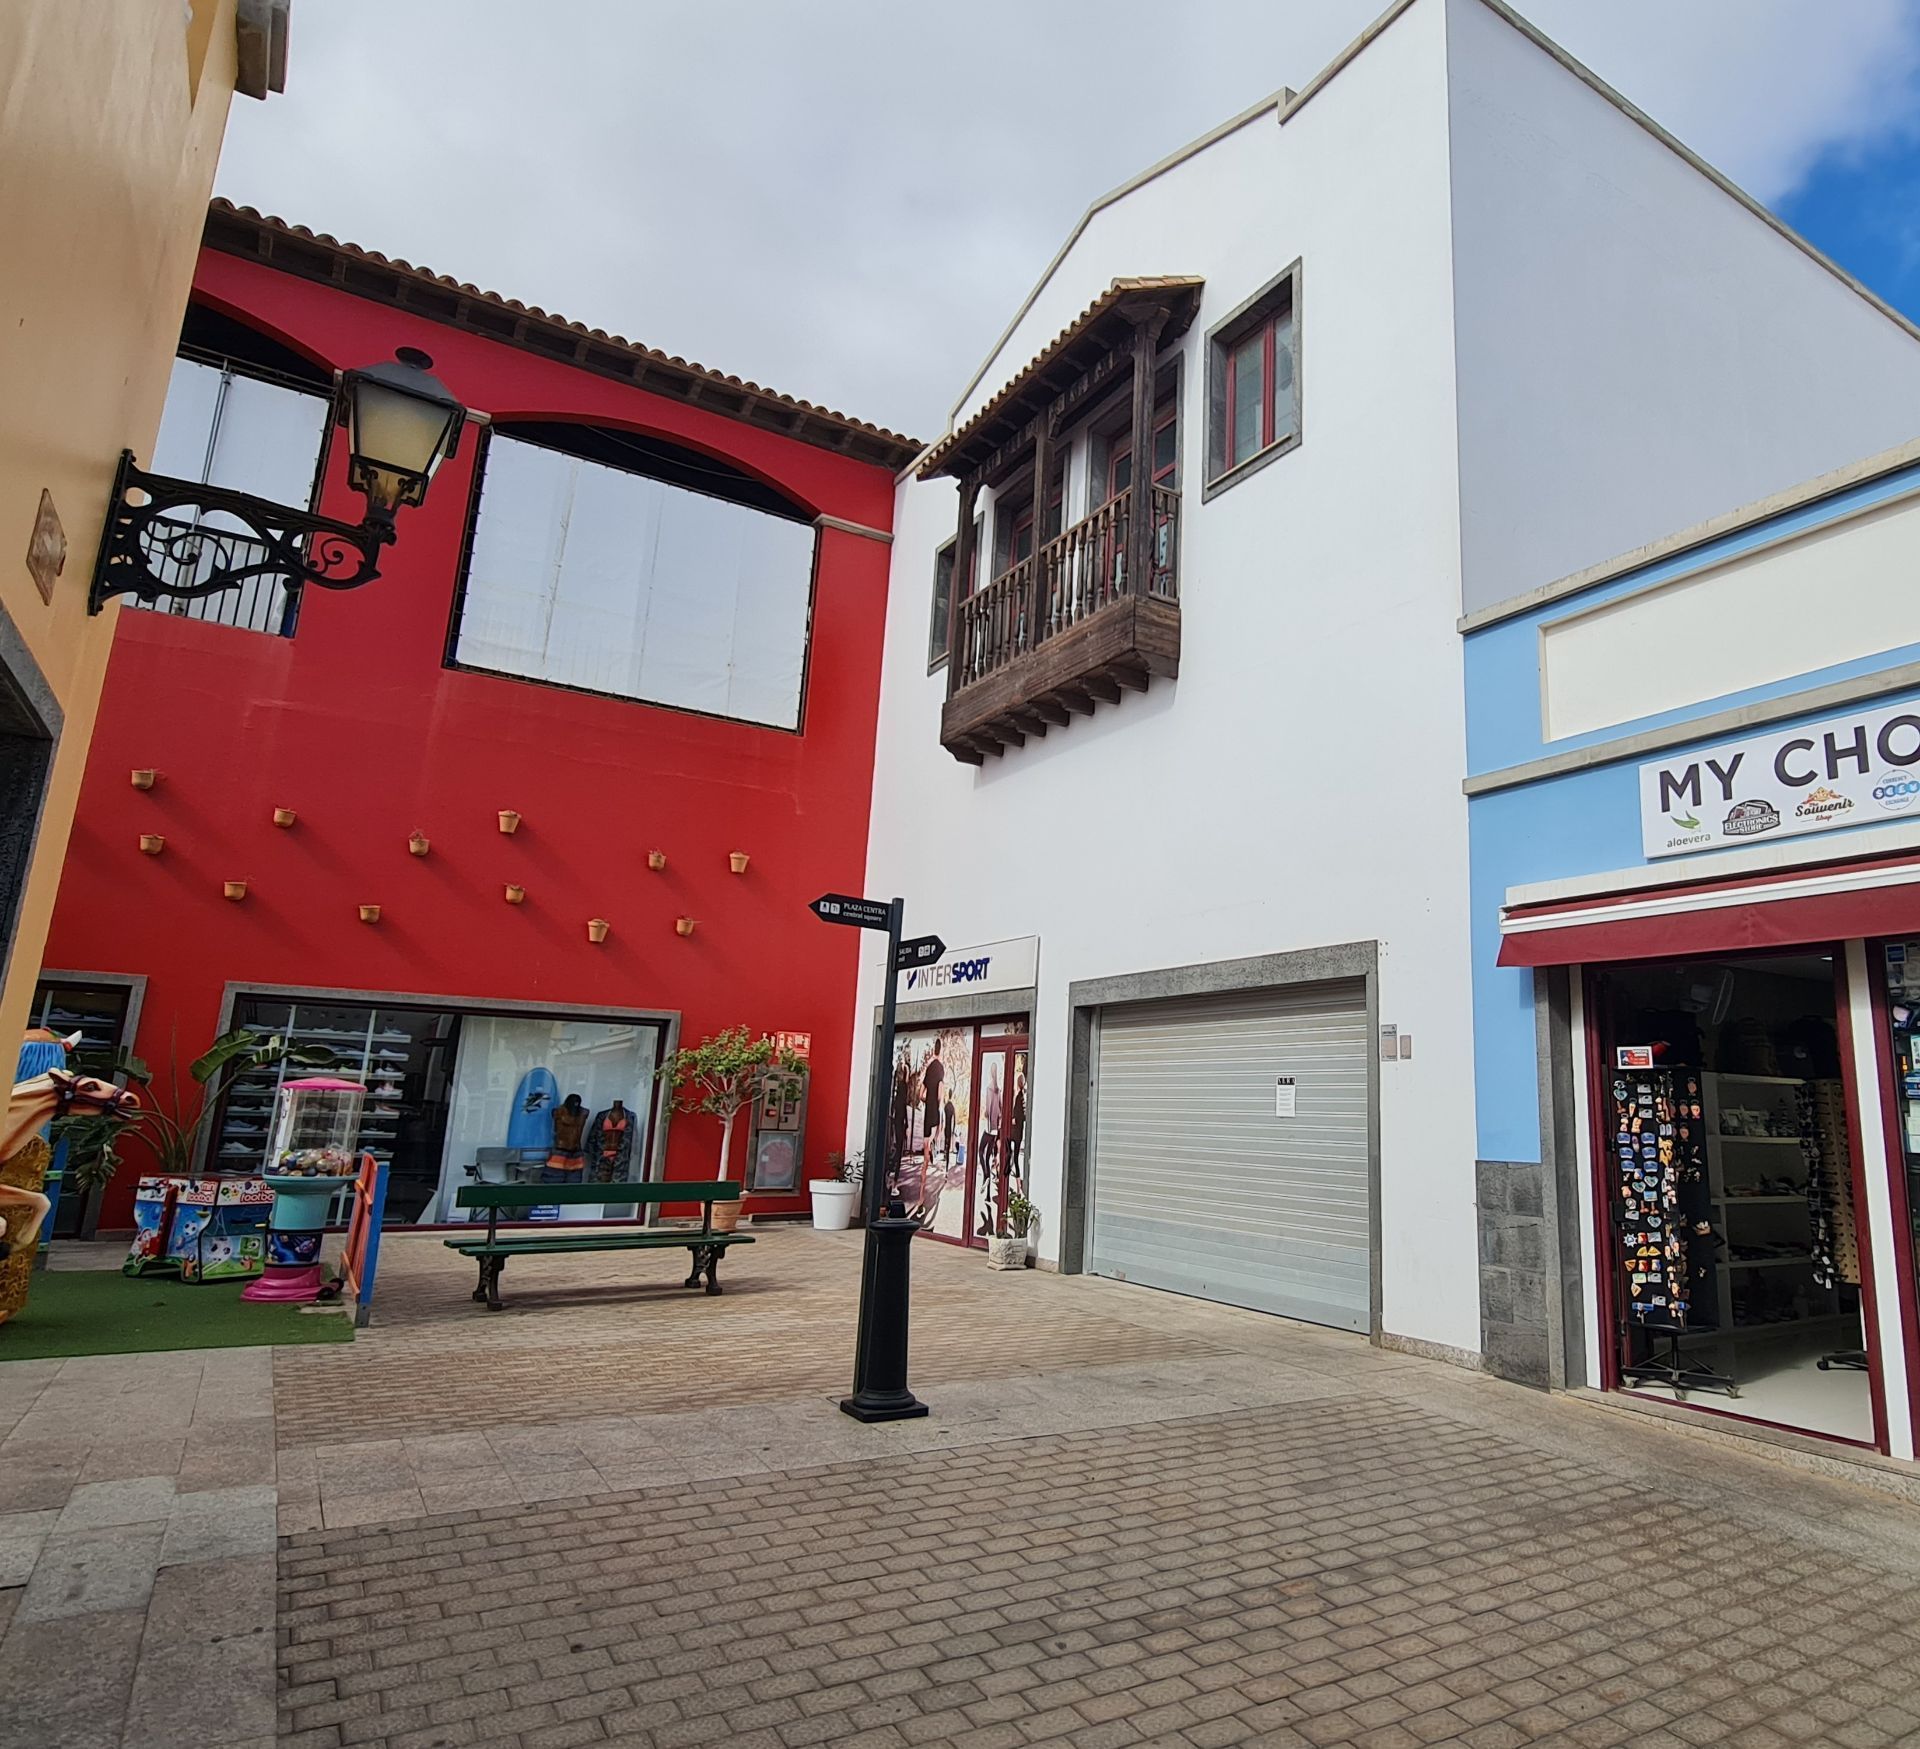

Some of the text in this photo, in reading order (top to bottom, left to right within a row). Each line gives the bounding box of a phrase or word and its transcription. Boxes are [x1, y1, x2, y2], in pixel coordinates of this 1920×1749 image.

[1658, 714, 1920, 813] MY CHO
[1795, 798, 1855, 817] Souvenir
[1667, 833, 1711, 848] aloevera
[843, 902, 863, 912] PLAZA
[917, 957, 990, 988] INTERSPORT
